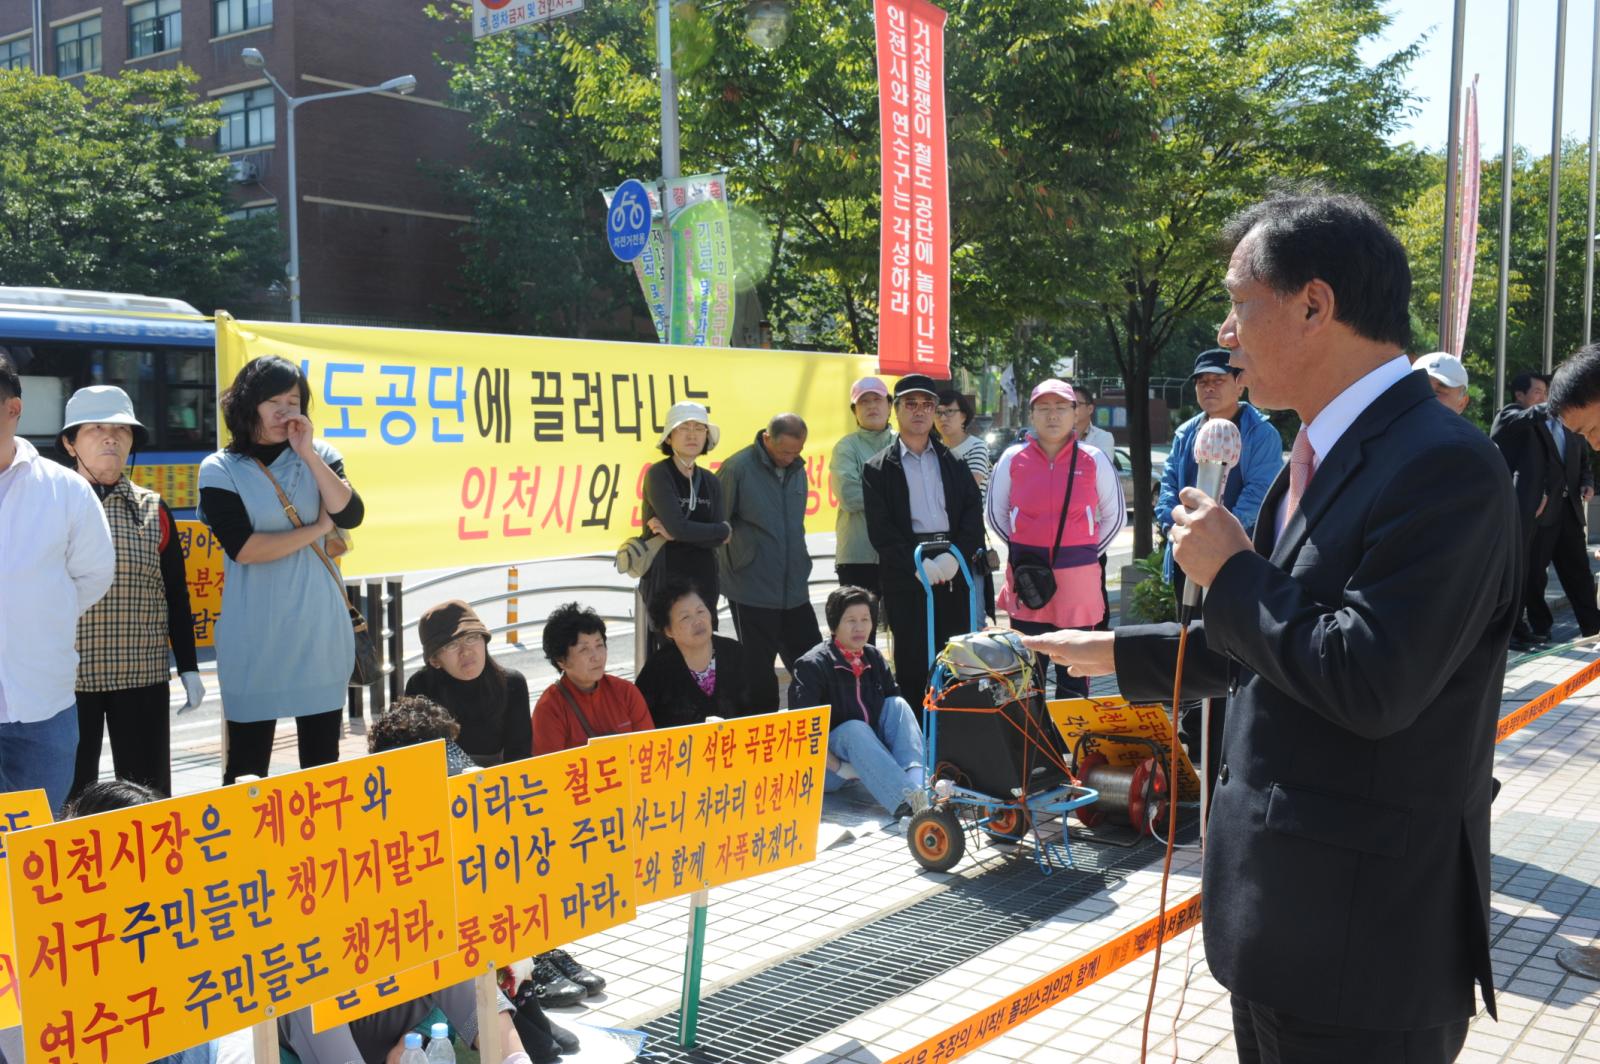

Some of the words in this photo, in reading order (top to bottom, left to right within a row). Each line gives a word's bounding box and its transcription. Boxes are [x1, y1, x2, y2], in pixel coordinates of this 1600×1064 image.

[886, 5, 910, 108] 인천시와
[912, 18, 933, 139] 거짓말쟁이
[891, 111, 911, 212] 연수구는
[914, 142, 933, 190] 철도
[890, 216, 912, 316] 각성하라
[914, 194, 934, 265] 공단에
[915, 269, 936, 363] 놀아나는
[301, 359, 512, 446] 도공단에
[458, 463, 621, 541] 인천시와
[629, 733, 693, 785] 열차의
[702, 728, 737, 773] 석탄
[744, 715, 823, 766] 곡물가루를
[22, 803, 232, 905] 인천시장은
[251, 764, 393, 847] 계양구와
[451, 773, 549, 834] 이라는
[563, 755, 623, 806] 철도
[694, 779, 747, 828] 차라리
[753, 766, 815, 816] 인천시와
[286, 829, 445, 916] 챙기지말고
[457, 826, 557, 894] 더이상
[569, 807, 627, 865] 주민
[671, 841, 706, 888] 함께
[560, 872, 628, 929] 마라.
[40, 985, 166, 1064] 연수구
[184, 936, 330, 1031] 주민들도
[342, 899, 445, 975] 챙겨라.
[932, 1023, 973, 1063] 주장의
[1007, 970, 1074, 1025] 폴리스라인과
